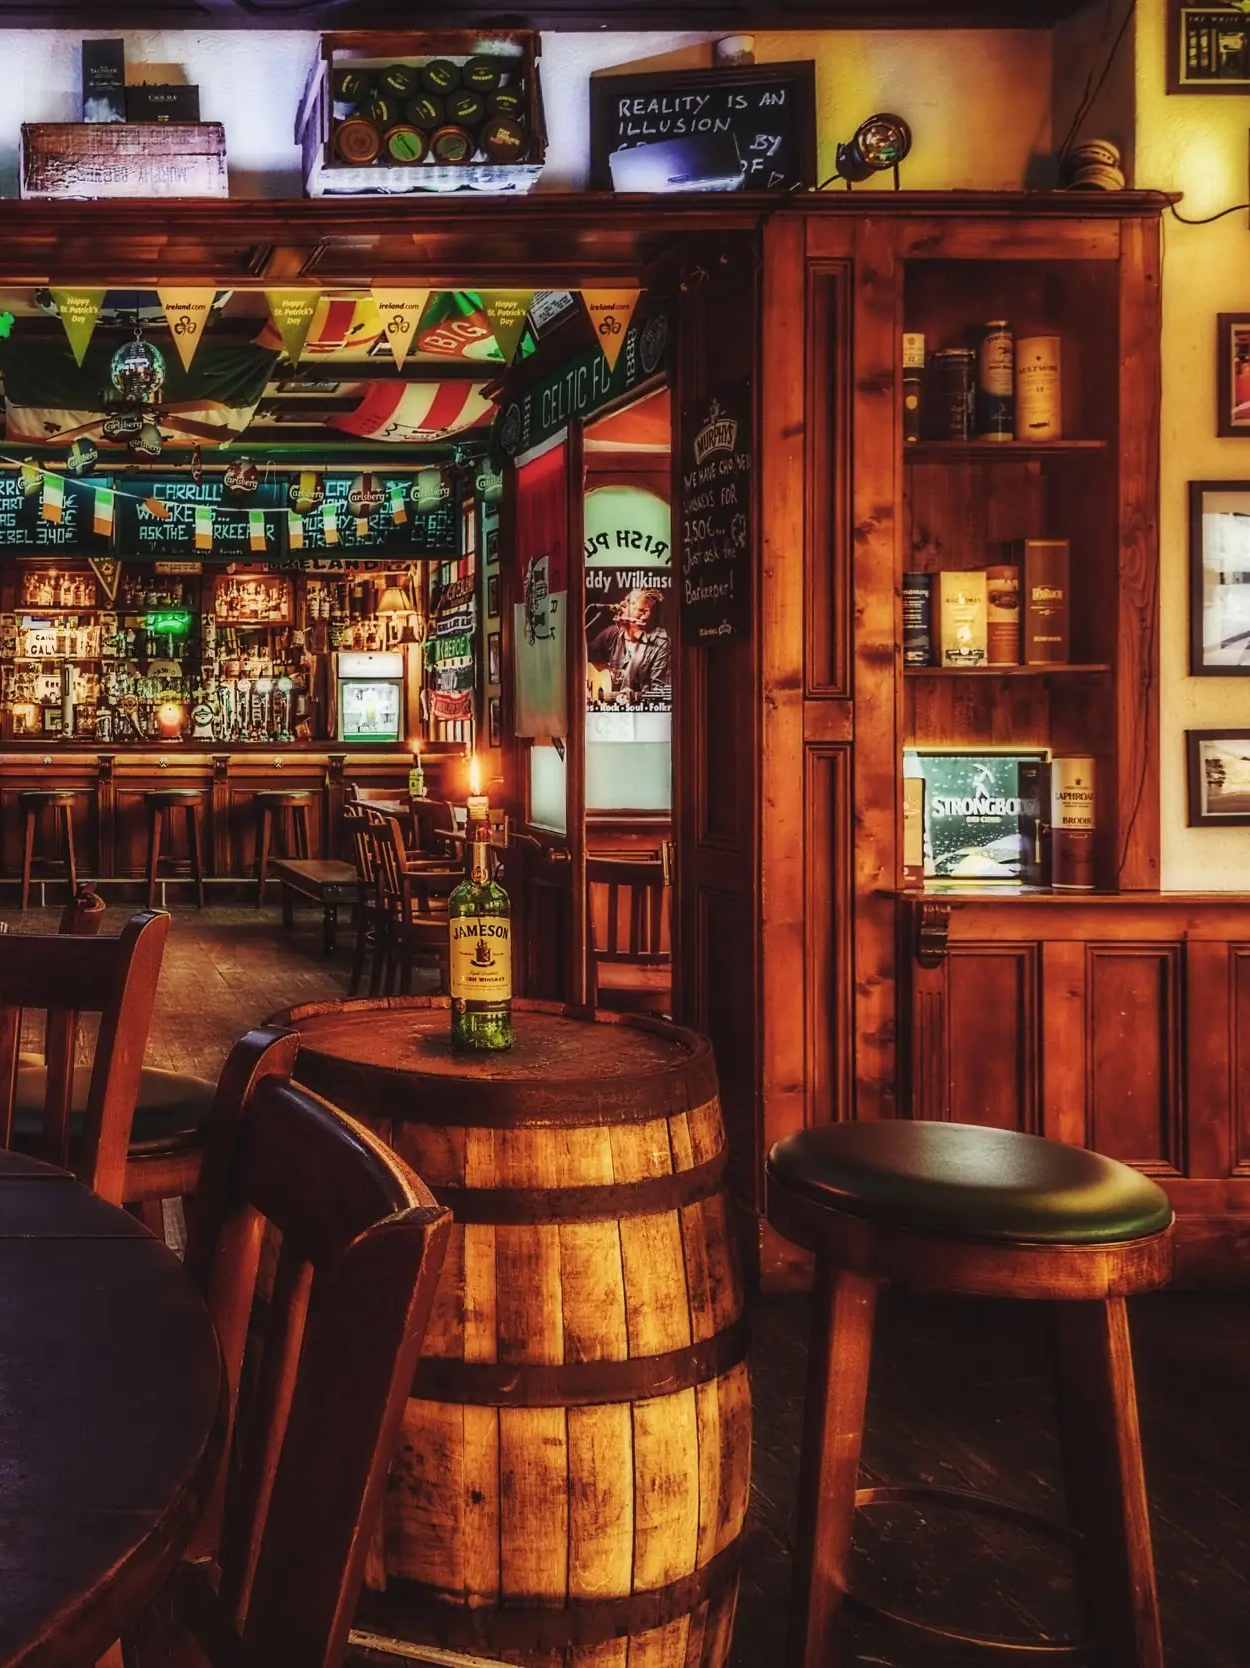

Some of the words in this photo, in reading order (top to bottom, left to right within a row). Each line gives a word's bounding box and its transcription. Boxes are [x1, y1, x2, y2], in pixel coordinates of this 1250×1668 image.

[618, 95, 710, 117] REALITY
[728, 95, 748, 110] IS
[758, 90, 786, 106] AN
[619, 118, 731, 136] ILLUSION
[750, 135, 782, 156] BY
[67, 297, 91, 307] Happy
[165, 303, 206, 311] ireland.com
[281, 299, 305, 309] Happy
[378, 302, 419, 311] ireland.com
[495, 300, 518, 310] Happy
[589, 303, 630, 311] ireland.com
[69, 305, 99, 314] Patrick's
[284, 307, 314, 316] Patrick's
[497, 309, 526, 317] Patrick's
[71, 314, 86, 324] Day
[287, 316, 301, 325] Day
[499, 318, 514, 326] Day
[542, 366, 587, 429] CELTIC
[103, 419, 143, 432] Carlsberg
[223, 472, 258, 490] Carlsberg
[153, 483, 223, 501] CARROLL'
[348, 489, 386, 502] Carlsberg
[585, 570, 611, 593] ddy
[600, 702, 620, 712] Rock
[625, 702, 644, 712] Soul
[649, 702, 671, 712] Folkr
[1056, 792, 1094, 800] LAPHROA
[931, 797, 1021, 817] STRONGBO
[453, 924, 509, 940] JAMESON
